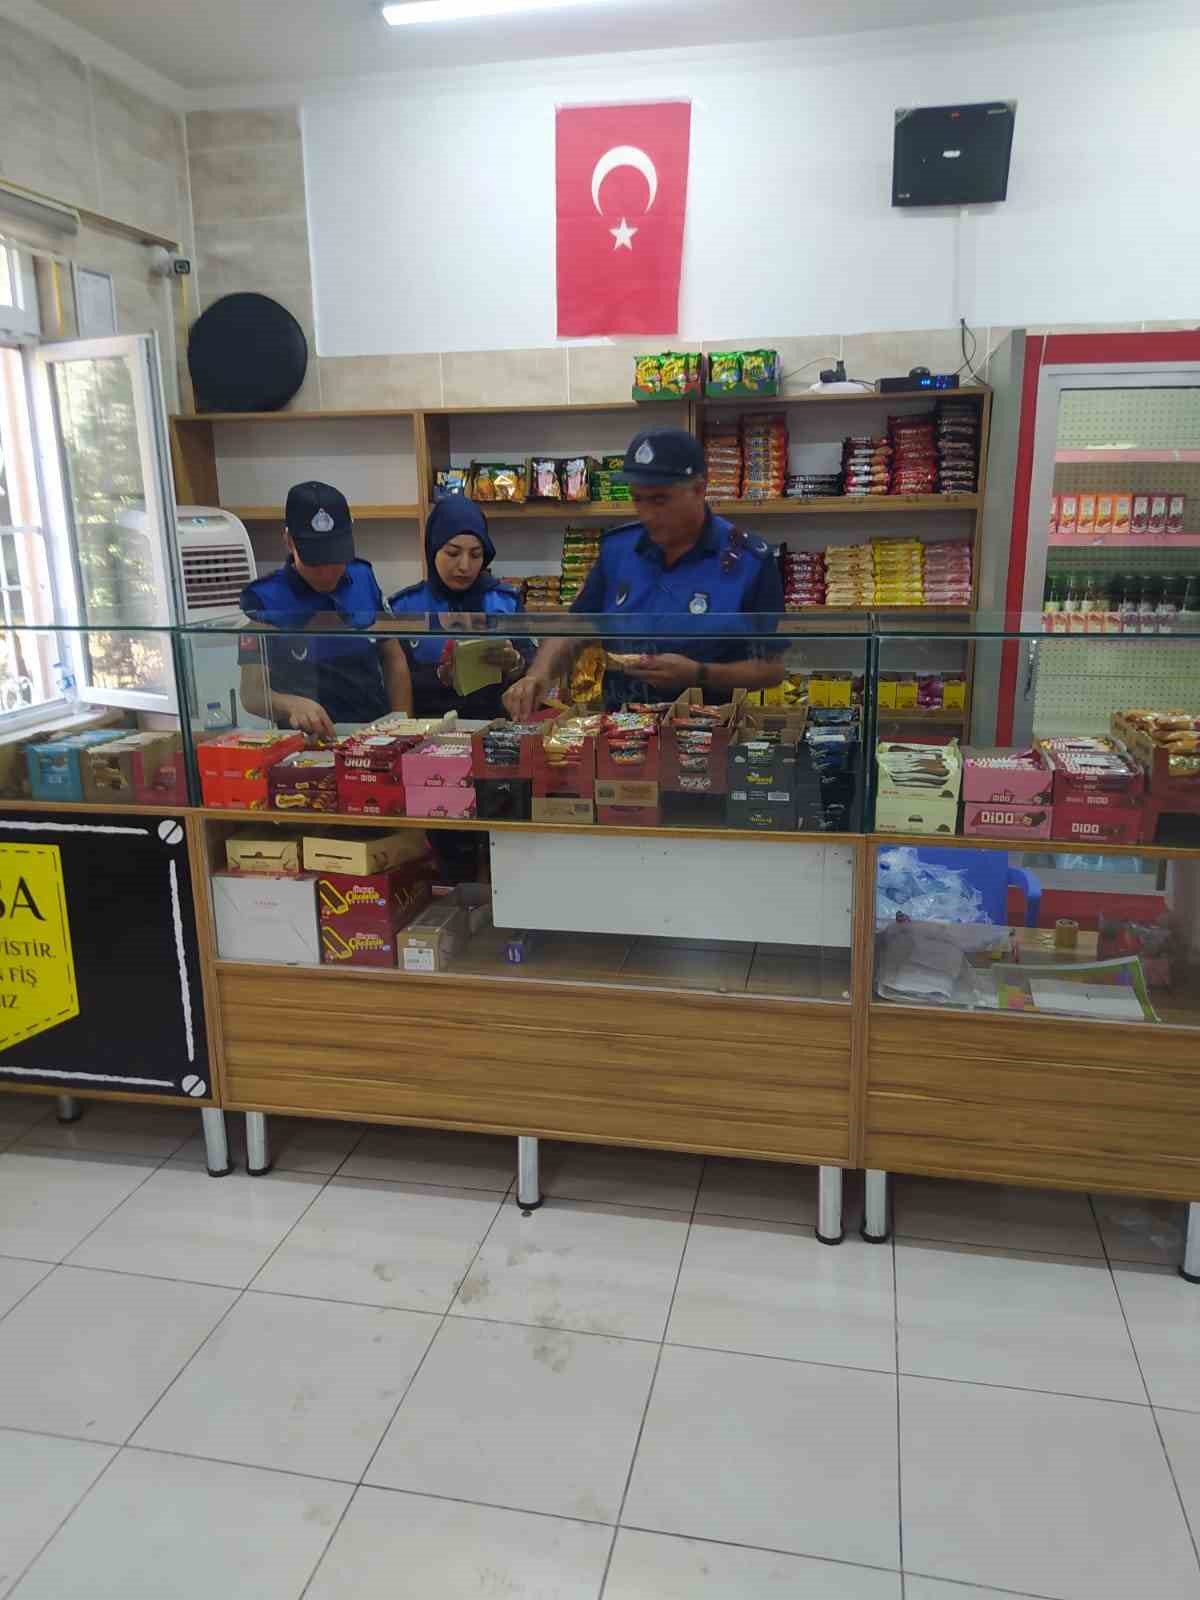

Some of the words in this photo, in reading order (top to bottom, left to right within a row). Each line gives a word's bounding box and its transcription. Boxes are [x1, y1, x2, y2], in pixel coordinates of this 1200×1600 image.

[1071, 823, 1100, 834] DIDO
[0, 875, 47, 921] A
[9, 964, 38, 988] FİŞ
[0, 993, 20, 1009] IZ
